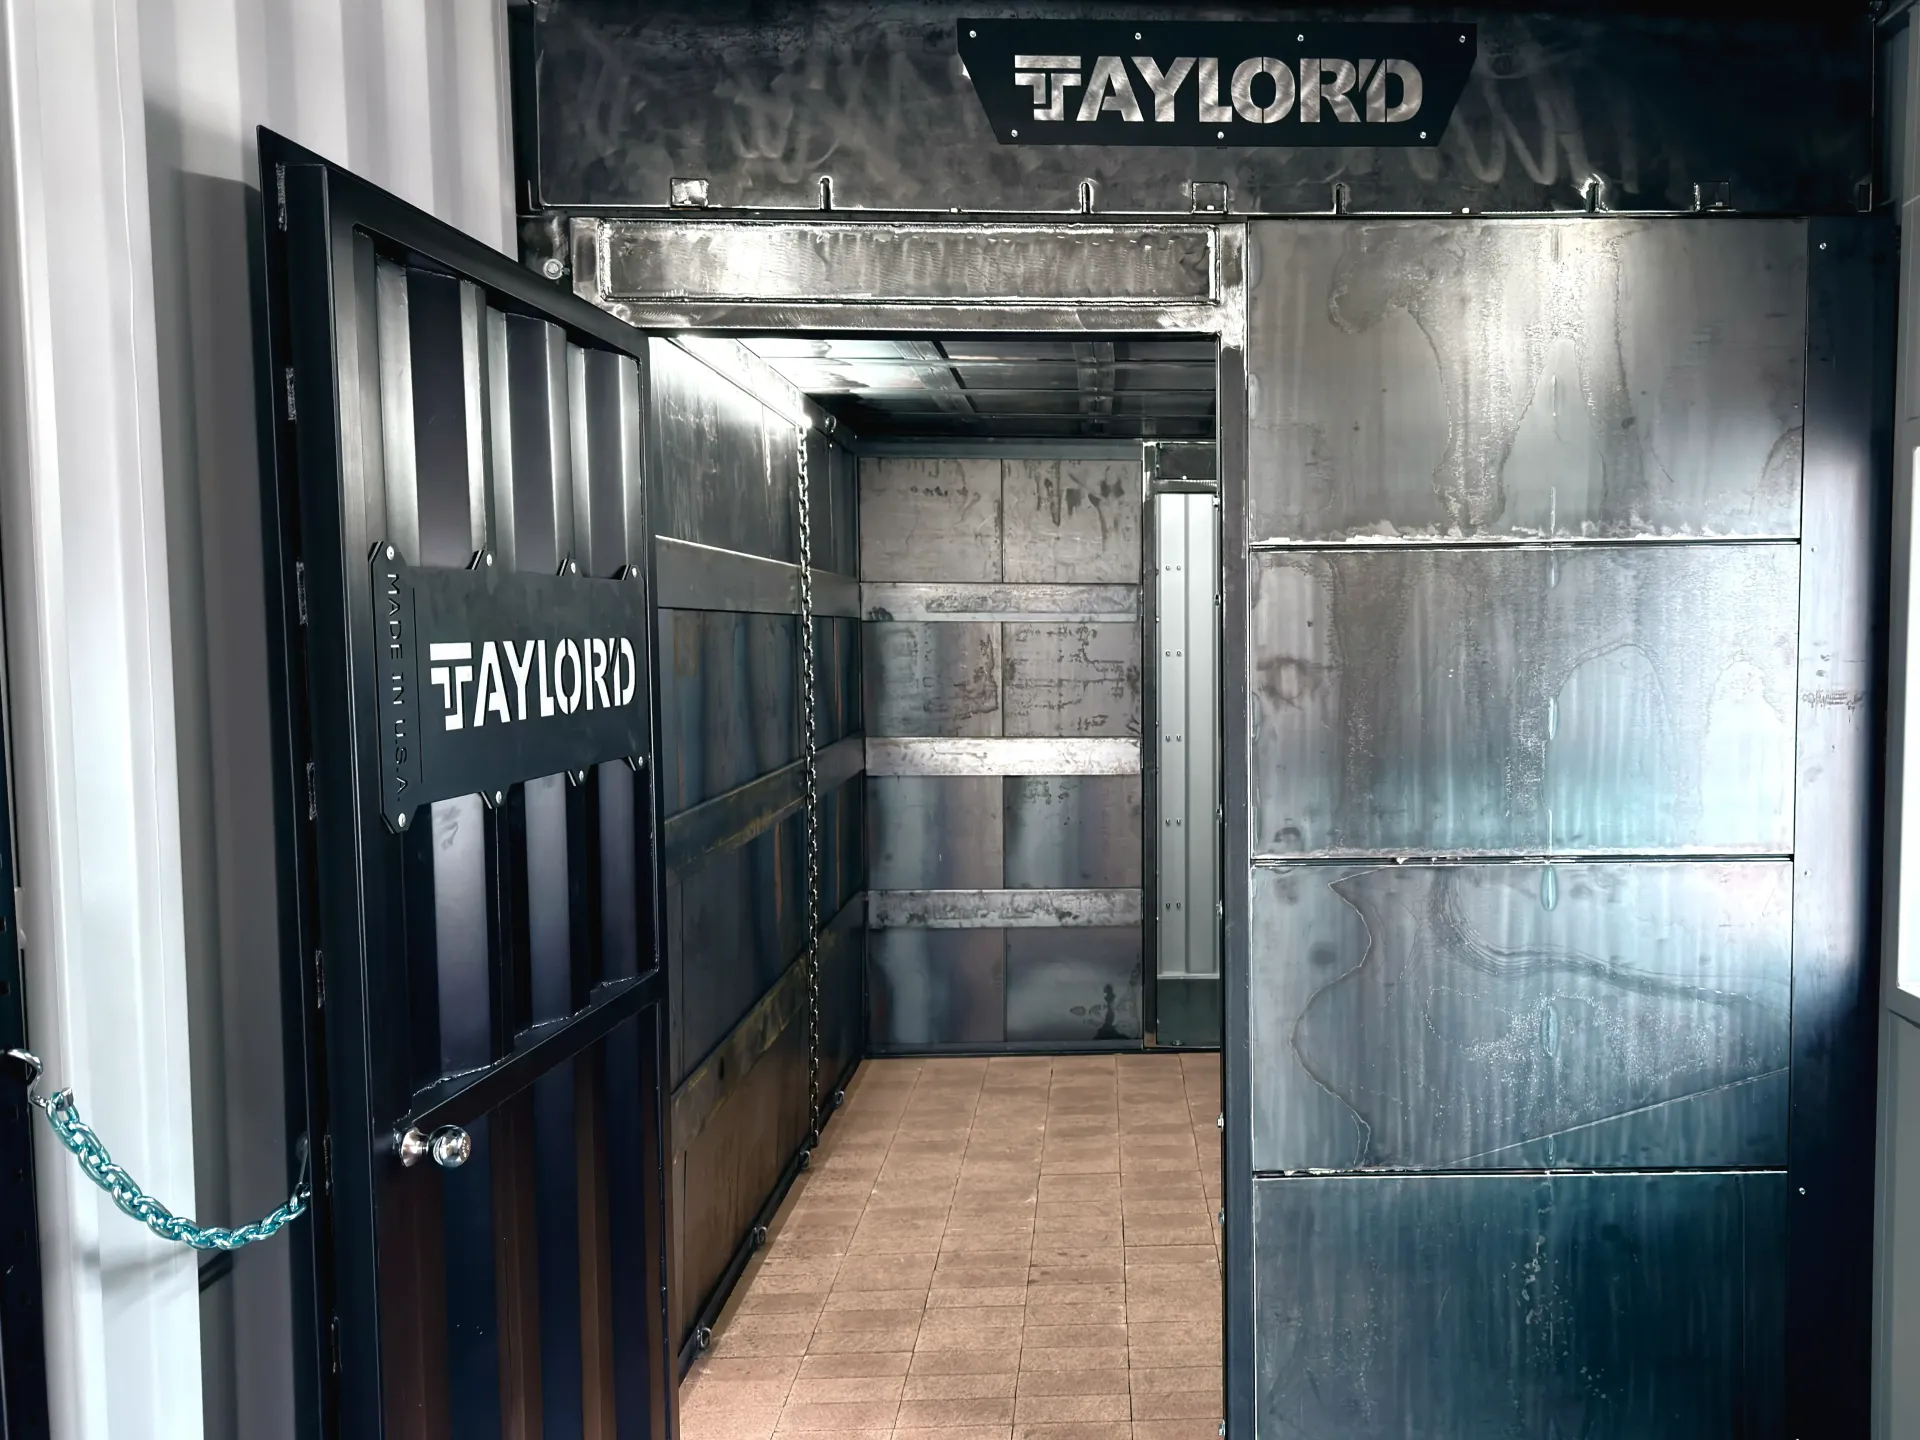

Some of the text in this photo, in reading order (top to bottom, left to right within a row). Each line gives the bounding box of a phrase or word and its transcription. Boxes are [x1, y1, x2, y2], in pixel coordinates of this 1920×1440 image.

[1014, 55, 1423, 124] TAYLOR'D
[387, 573, 408, 803] MADE IN U.S.A.
[429, 637, 637, 732] TAYLOR'D
